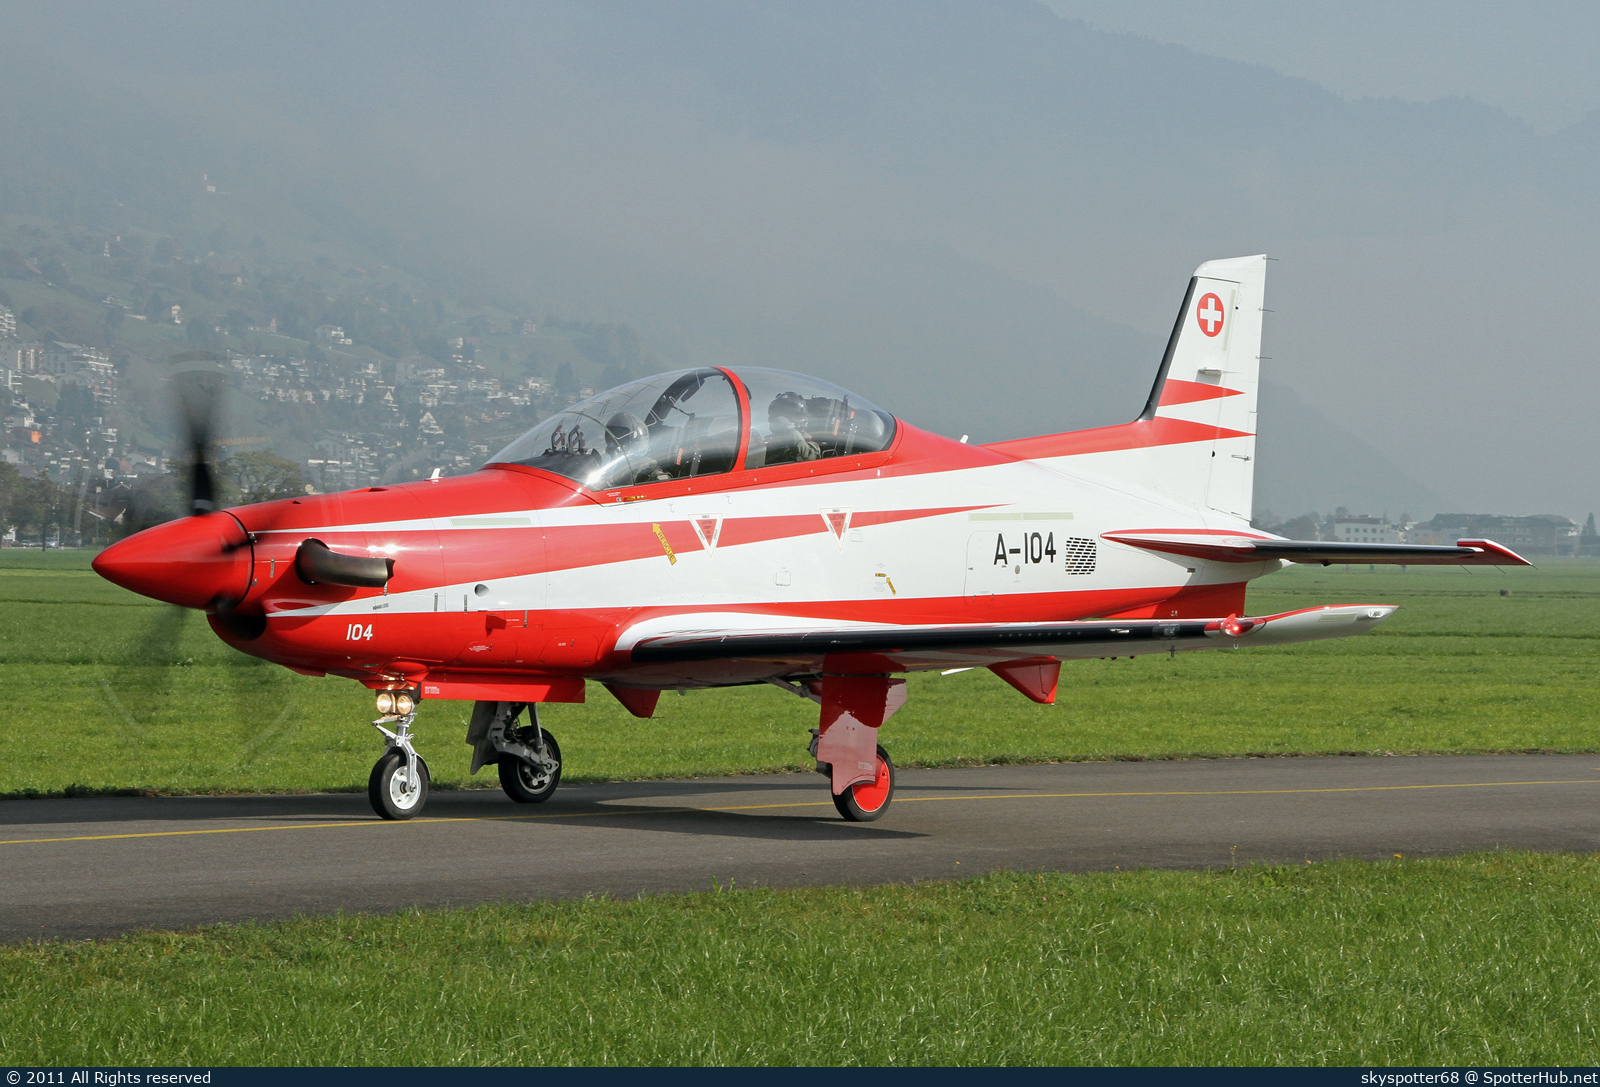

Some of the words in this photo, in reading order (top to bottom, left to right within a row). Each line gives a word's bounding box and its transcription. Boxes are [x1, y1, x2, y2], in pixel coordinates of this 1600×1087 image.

[657, 531, 675, 560] RESCUE
[994, 532, 1056, 565] A-104
[346, 624, 373, 641] 104
